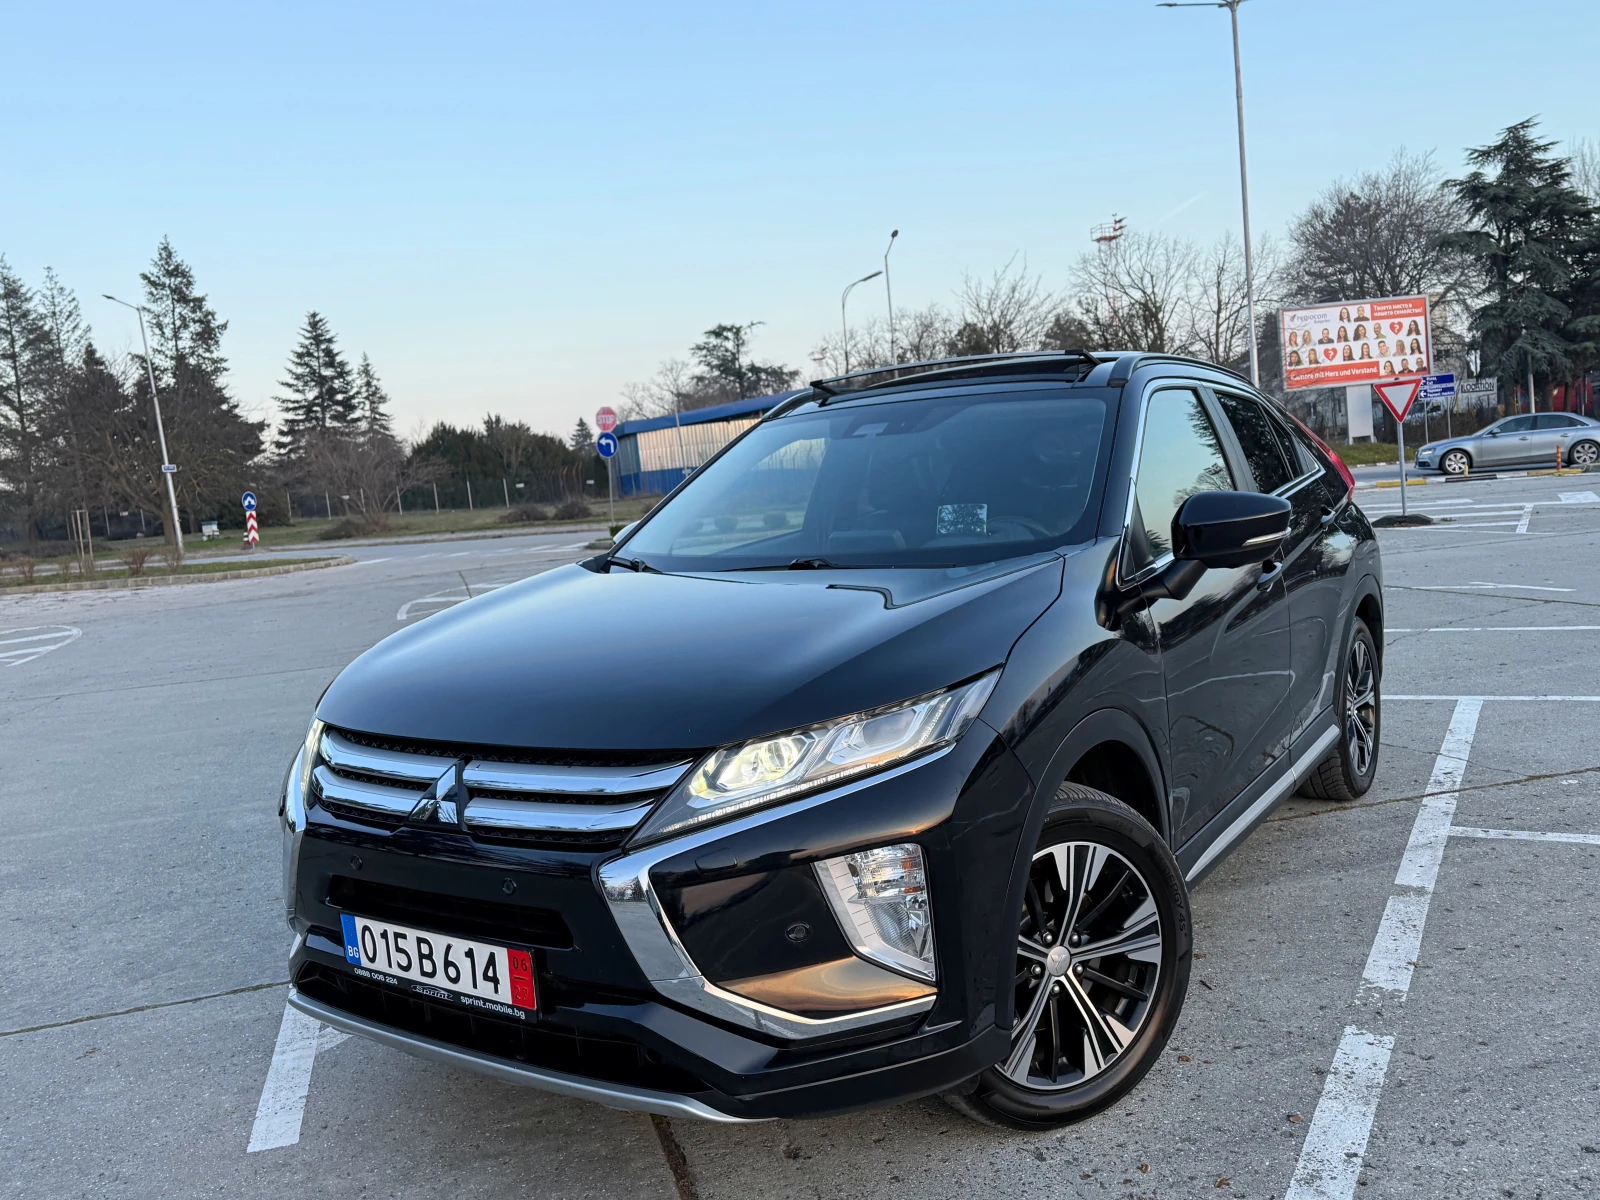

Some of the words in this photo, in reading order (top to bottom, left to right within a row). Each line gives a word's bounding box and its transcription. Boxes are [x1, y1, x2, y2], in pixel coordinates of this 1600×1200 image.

[1351, 366, 1379, 375] Verstand.
[597, 414, 615, 424] STOP
[347, 945, 359, 959] BG
[512, 956, 528, 972] 06
[514, 985, 528, 1001] 27
[460, 995, 526, 1020] sprint.mobile.bg
